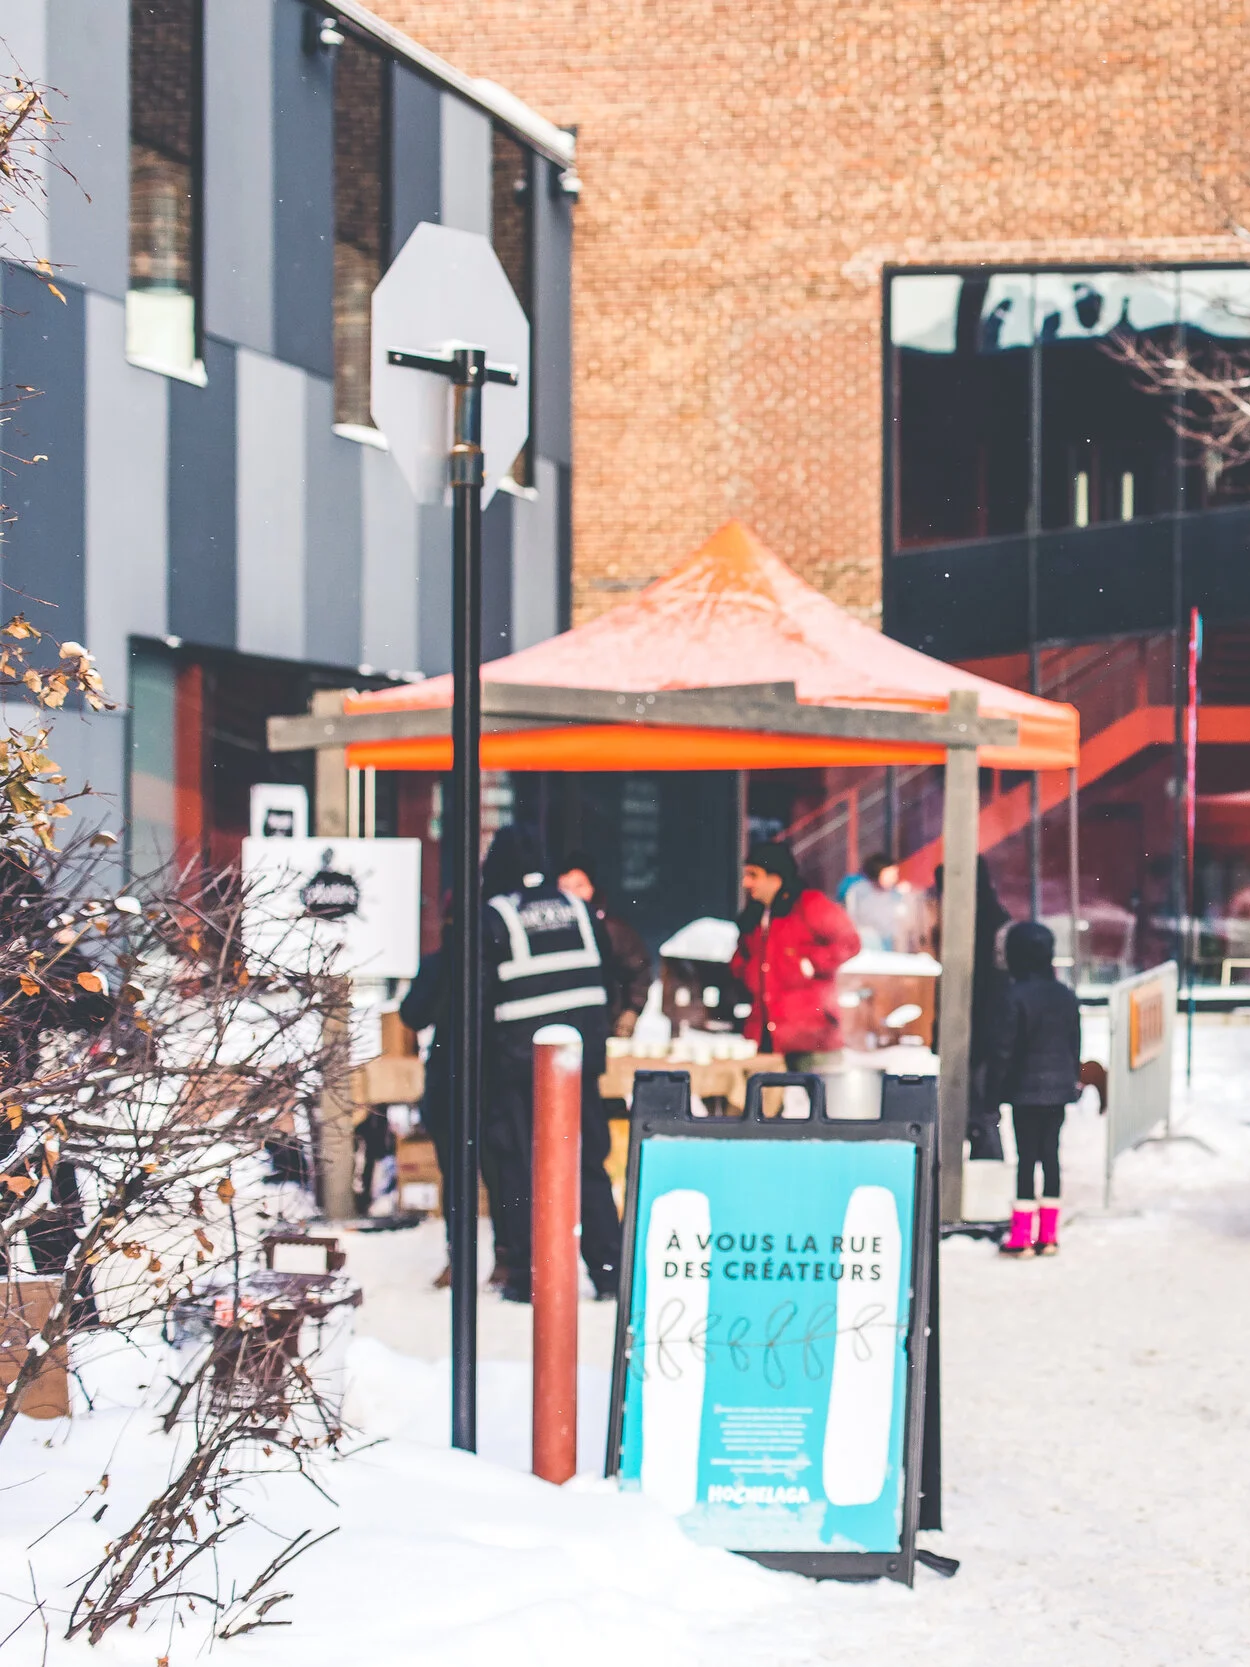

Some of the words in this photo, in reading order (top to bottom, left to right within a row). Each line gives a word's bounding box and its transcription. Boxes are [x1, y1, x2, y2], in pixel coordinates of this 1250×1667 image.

[666, 1229, 682, 1251] À
[697, 1233, 775, 1253] VOUS
[786, 1234, 819, 1254] LA
[831, 1235, 883, 1254] RUE
[664, 1261, 713, 1279] DES
[723, 1257, 882, 1282] CRÉATEURS
